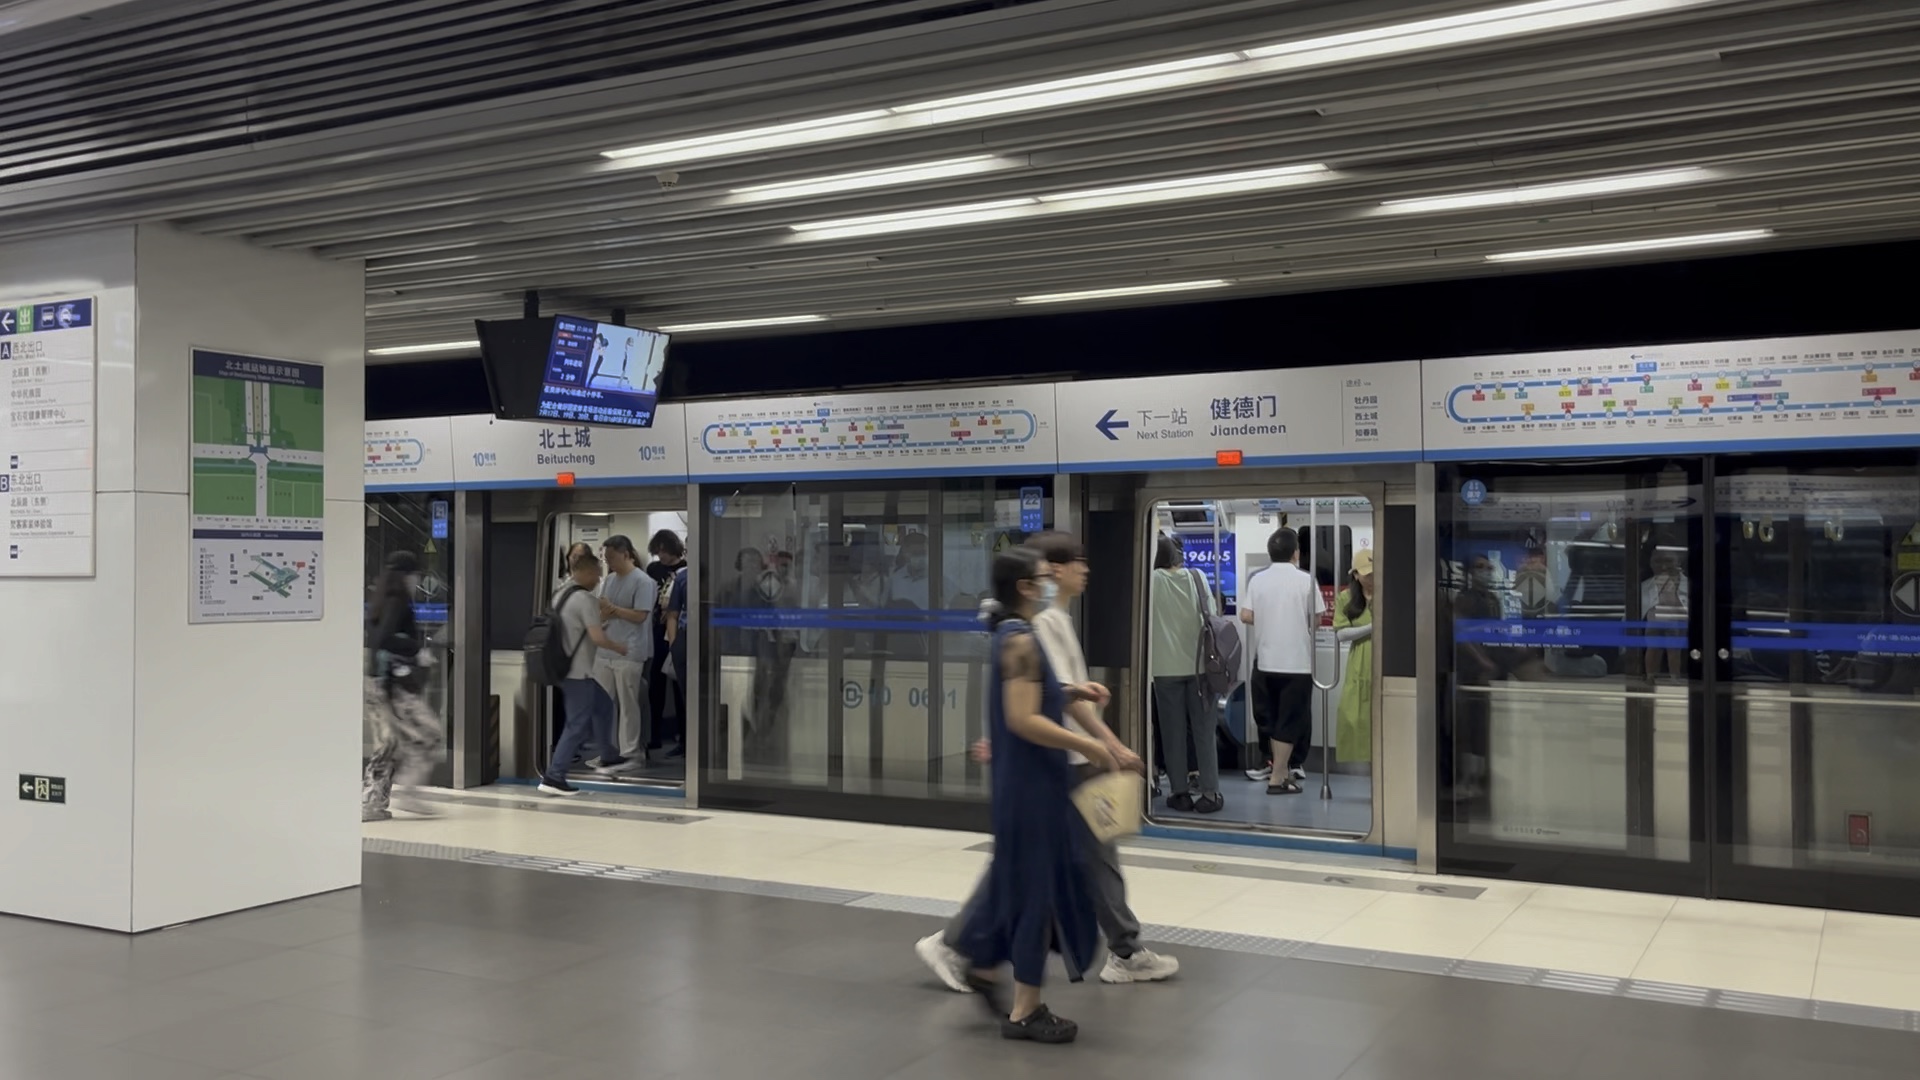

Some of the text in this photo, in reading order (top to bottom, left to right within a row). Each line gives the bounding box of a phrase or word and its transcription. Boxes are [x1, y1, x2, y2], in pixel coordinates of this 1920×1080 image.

[2, 343, 10, 358] A
[13, 341, 42, 354] 西北出口
[1210, 396, 1277, 420] 健德门
[1137, 408, 1188, 427] 下一站
[1137, 429, 1194, 440] Next Station
[1210, 423, 1287, 437] Jiandemen
[539, 426, 591, 449] 北土城
[537, 453, 595, 465] Beitucheng
[0, 476, 8, 489] B
[11, 473, 41, 486] 东北出口
